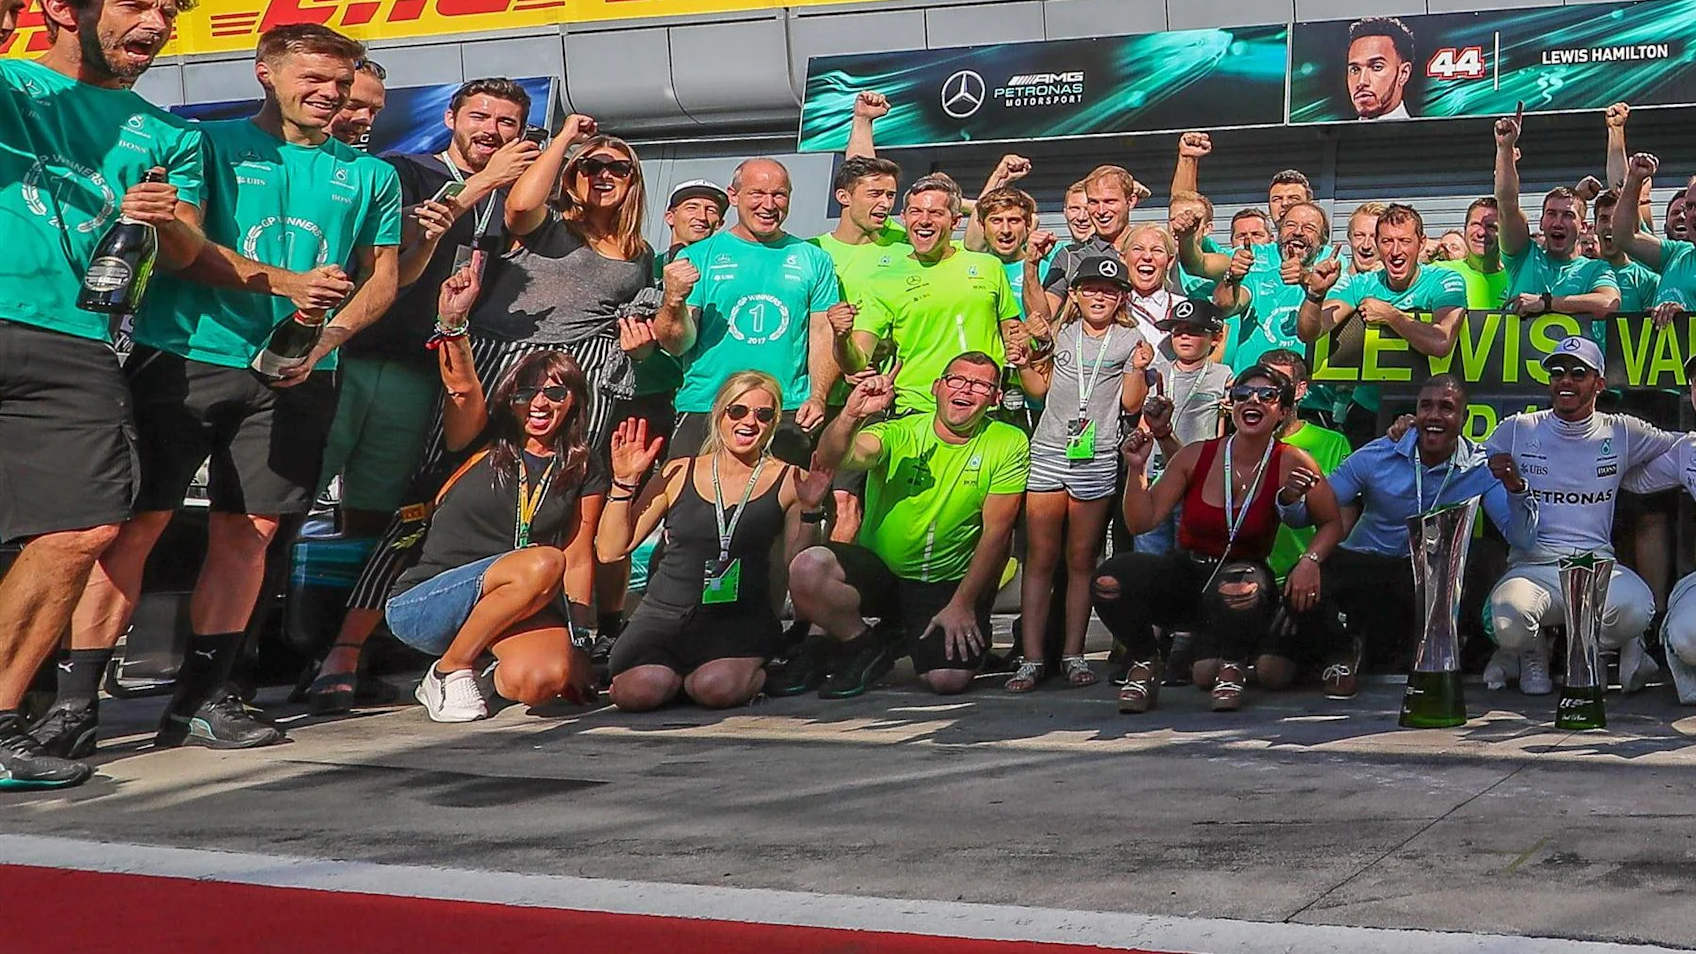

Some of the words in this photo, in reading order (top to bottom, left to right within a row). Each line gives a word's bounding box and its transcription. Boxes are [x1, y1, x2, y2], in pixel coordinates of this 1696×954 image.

[1541, 47, 1588, 66] LEWIS
[1591, 43, 1669, 62] HAMILTON
[1427, 45, 1486, 81] 44
[1036, 71, 1084, 84] AMG
[994, 82, 1084, 99] PETRONAS
[1005, 94, 1084, 108] MOTORSPORT
[117, 139, 150, 155] BOSS
[246, 177, 267, 187] UBS
[260, 216, 276, 228] GP
[737, 295, 750, 307] GP
[749, 294, 782, 308] WINNERS
[748, 303, 765, 333] 1
[746, 337, 766, 346] 2017
[1529, 464, 1549, 476] UBS
[1530, 489, 1613, 505] ETRONAS
